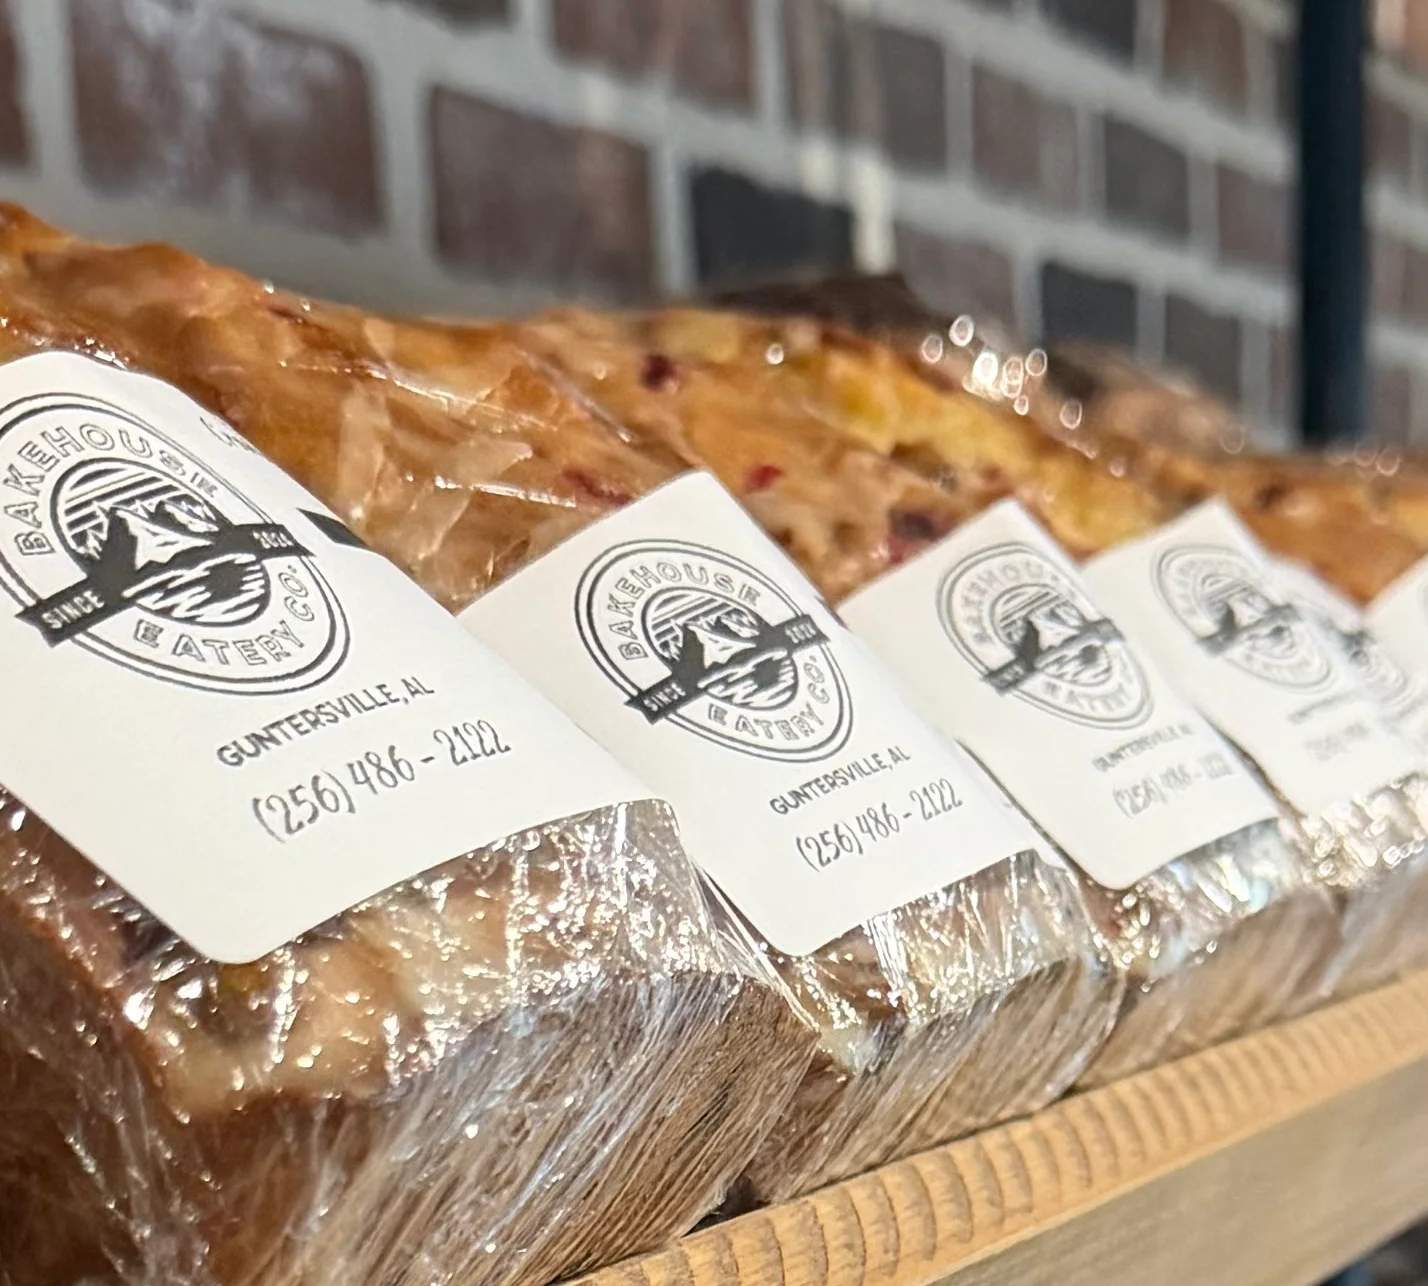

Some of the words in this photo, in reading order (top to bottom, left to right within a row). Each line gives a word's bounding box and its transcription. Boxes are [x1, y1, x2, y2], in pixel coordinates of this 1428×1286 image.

[4, 423, 219, 555] BAKEHOUSE
[40, 590, 104, 629] SINCE
[133, 619, 306, 667] EATERY
[607, 561, 761, 661] BAKEHOUSE
[643, 682, 686, 713] SINCE
[708, 703, 824, 741] EATERY
[252, 770, 356, 844] (256)
[347, 745, 415, 795] 486
[434, 719, 511, 766] 2122
[796, 821, 864, 872] (256)
[856, 802, 900, 842] 486
[909, 778, 963, 821] 2122
